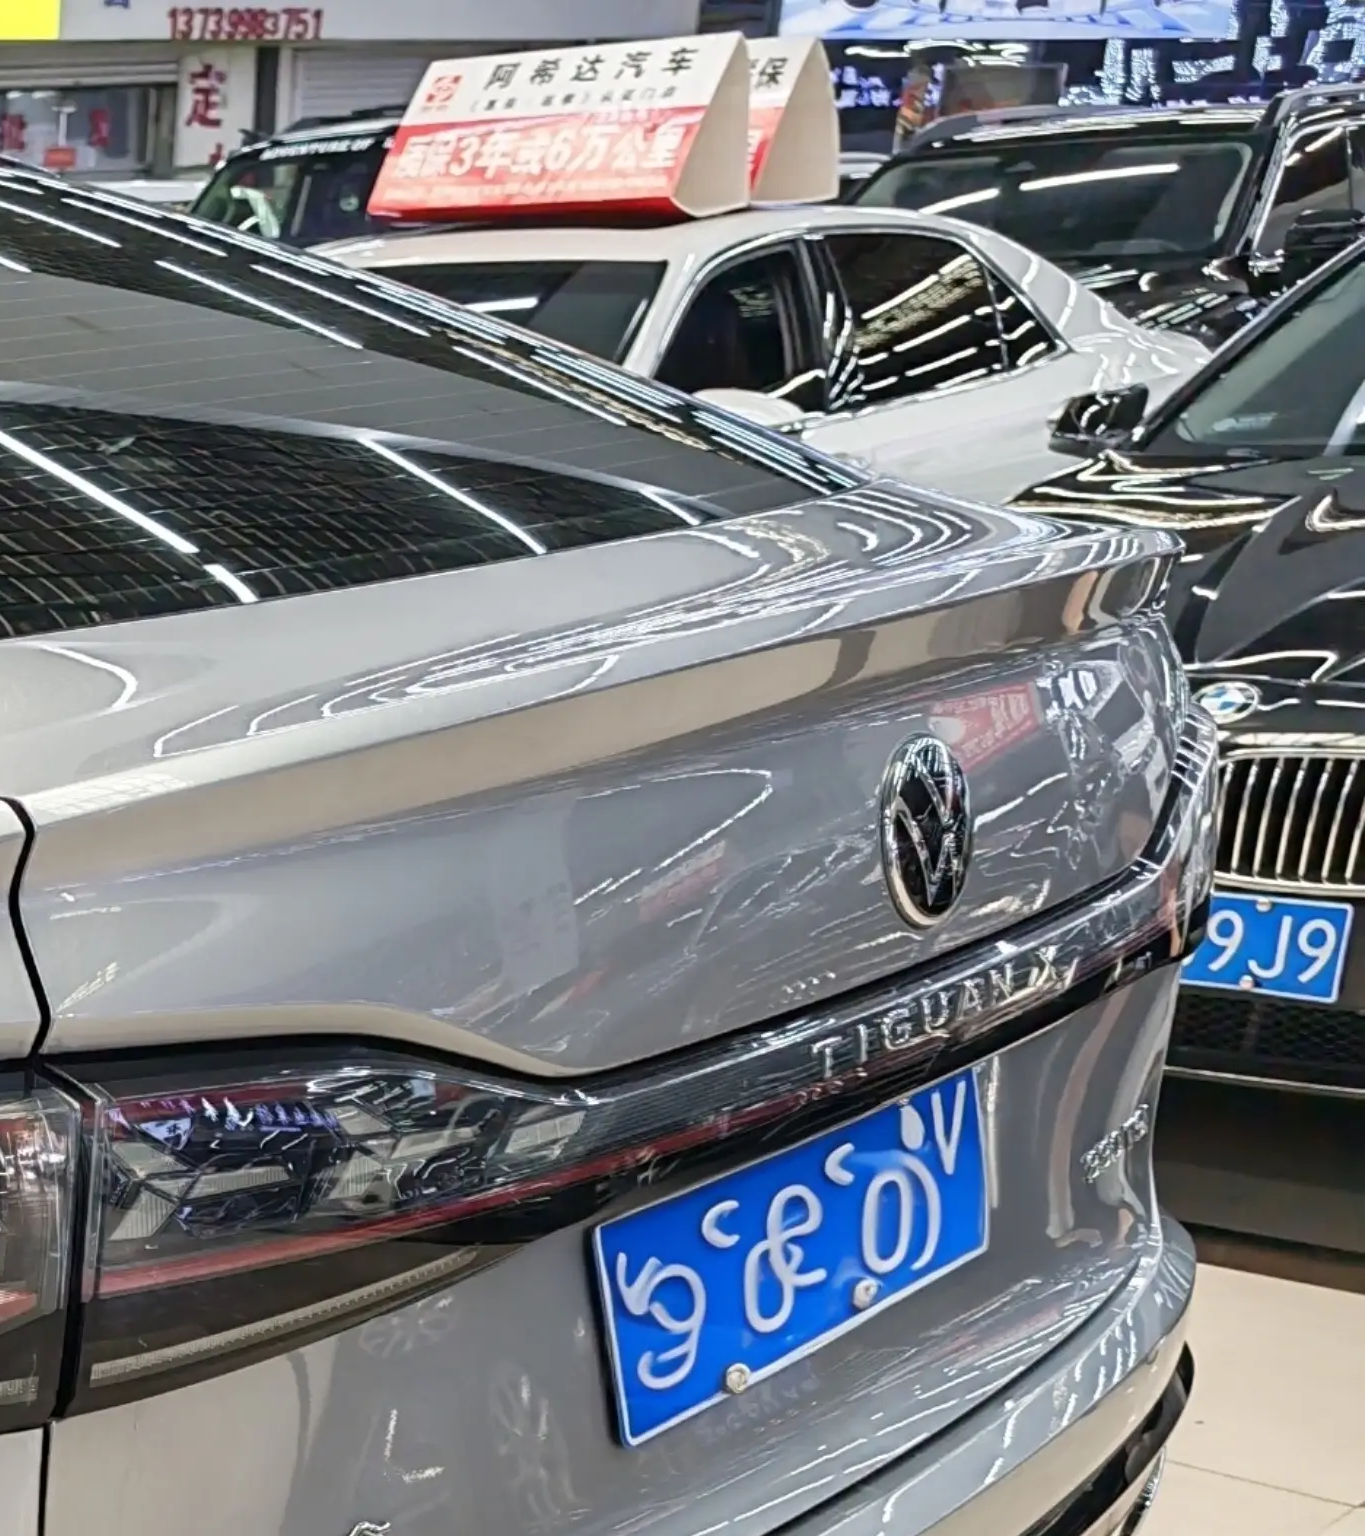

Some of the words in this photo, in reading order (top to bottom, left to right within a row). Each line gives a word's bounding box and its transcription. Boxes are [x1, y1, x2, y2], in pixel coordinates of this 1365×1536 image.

[483, 47, 699, 91] 阿希达汽车
[1183, 908, 1337, 984] 9J9
